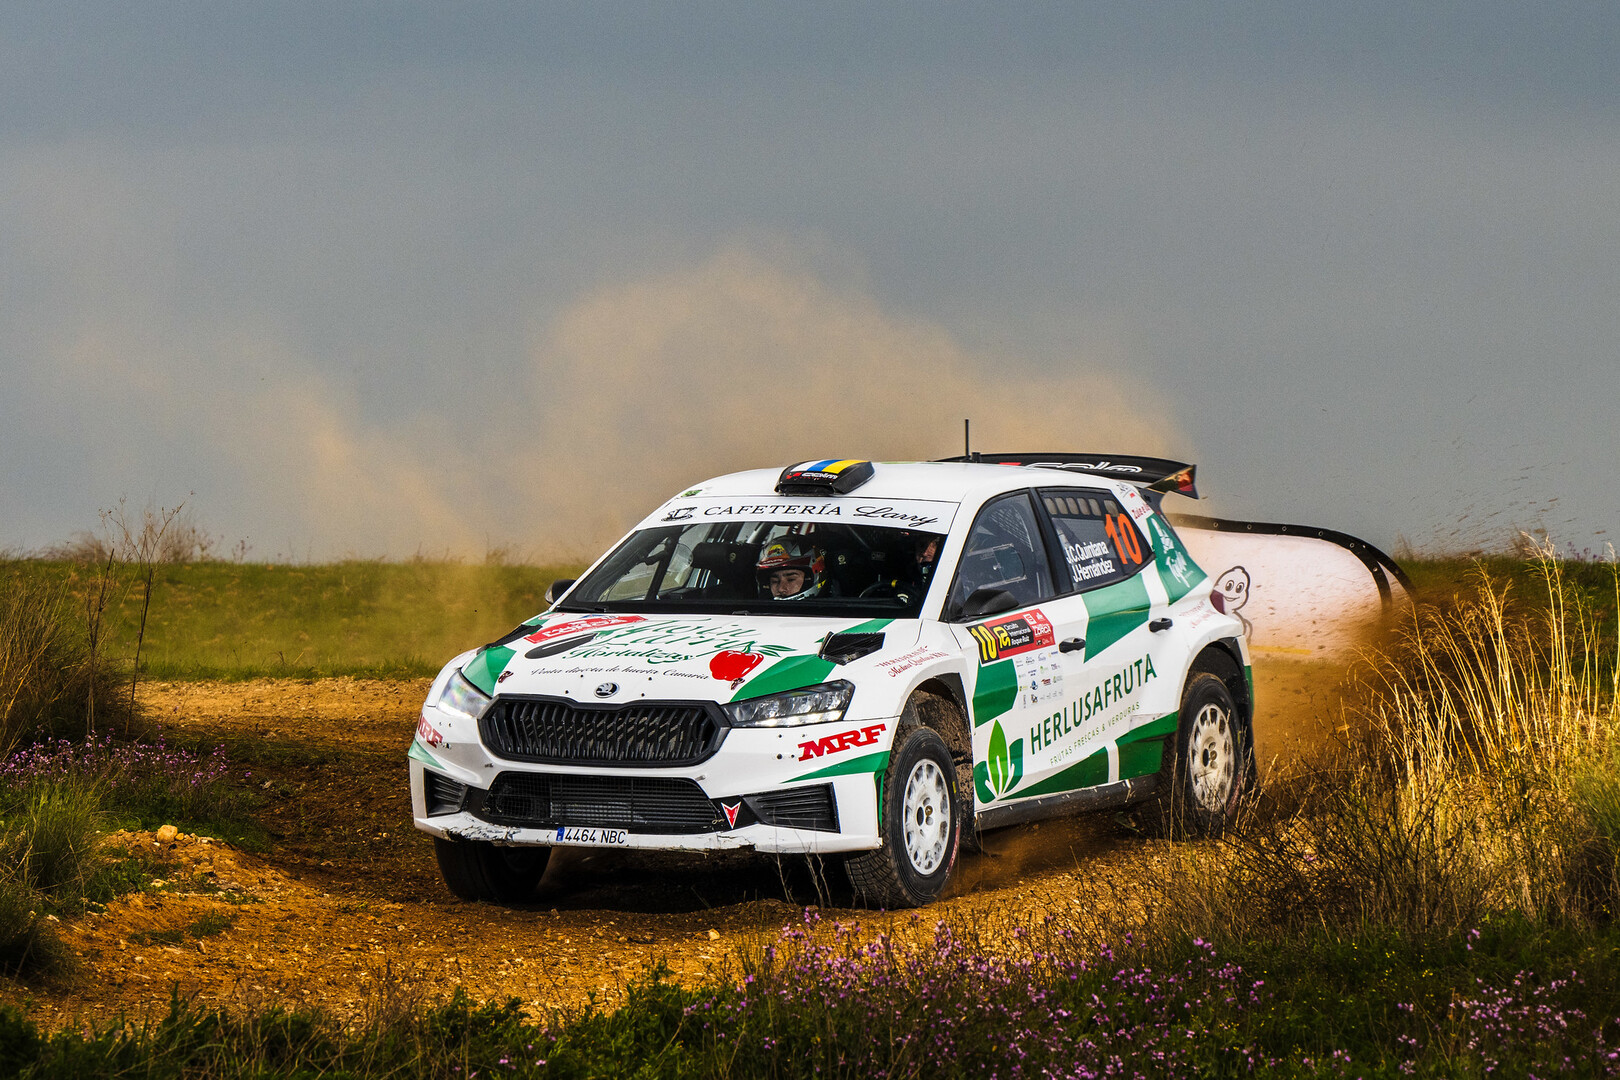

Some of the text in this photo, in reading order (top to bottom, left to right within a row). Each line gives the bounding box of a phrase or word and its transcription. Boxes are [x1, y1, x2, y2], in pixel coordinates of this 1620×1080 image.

[703, 503, 939, 528] CAFETERÍA Larry
[1104, 513, 1143, 565] 10
[971, 625, 998, 661] 10
[1030, 653, 1158, 755] HERLUSAFRUTA
[797, 723, 887, 762] MRF
[1049, 745, 1073, 767] FRUTAS
[1073, 726, 1100, 749] FRESCAS
[1107, 701, 1141, 728] VERDURAS
[564, 828, 597, 843] 4464
[600, 829, 626, 844] NBC
